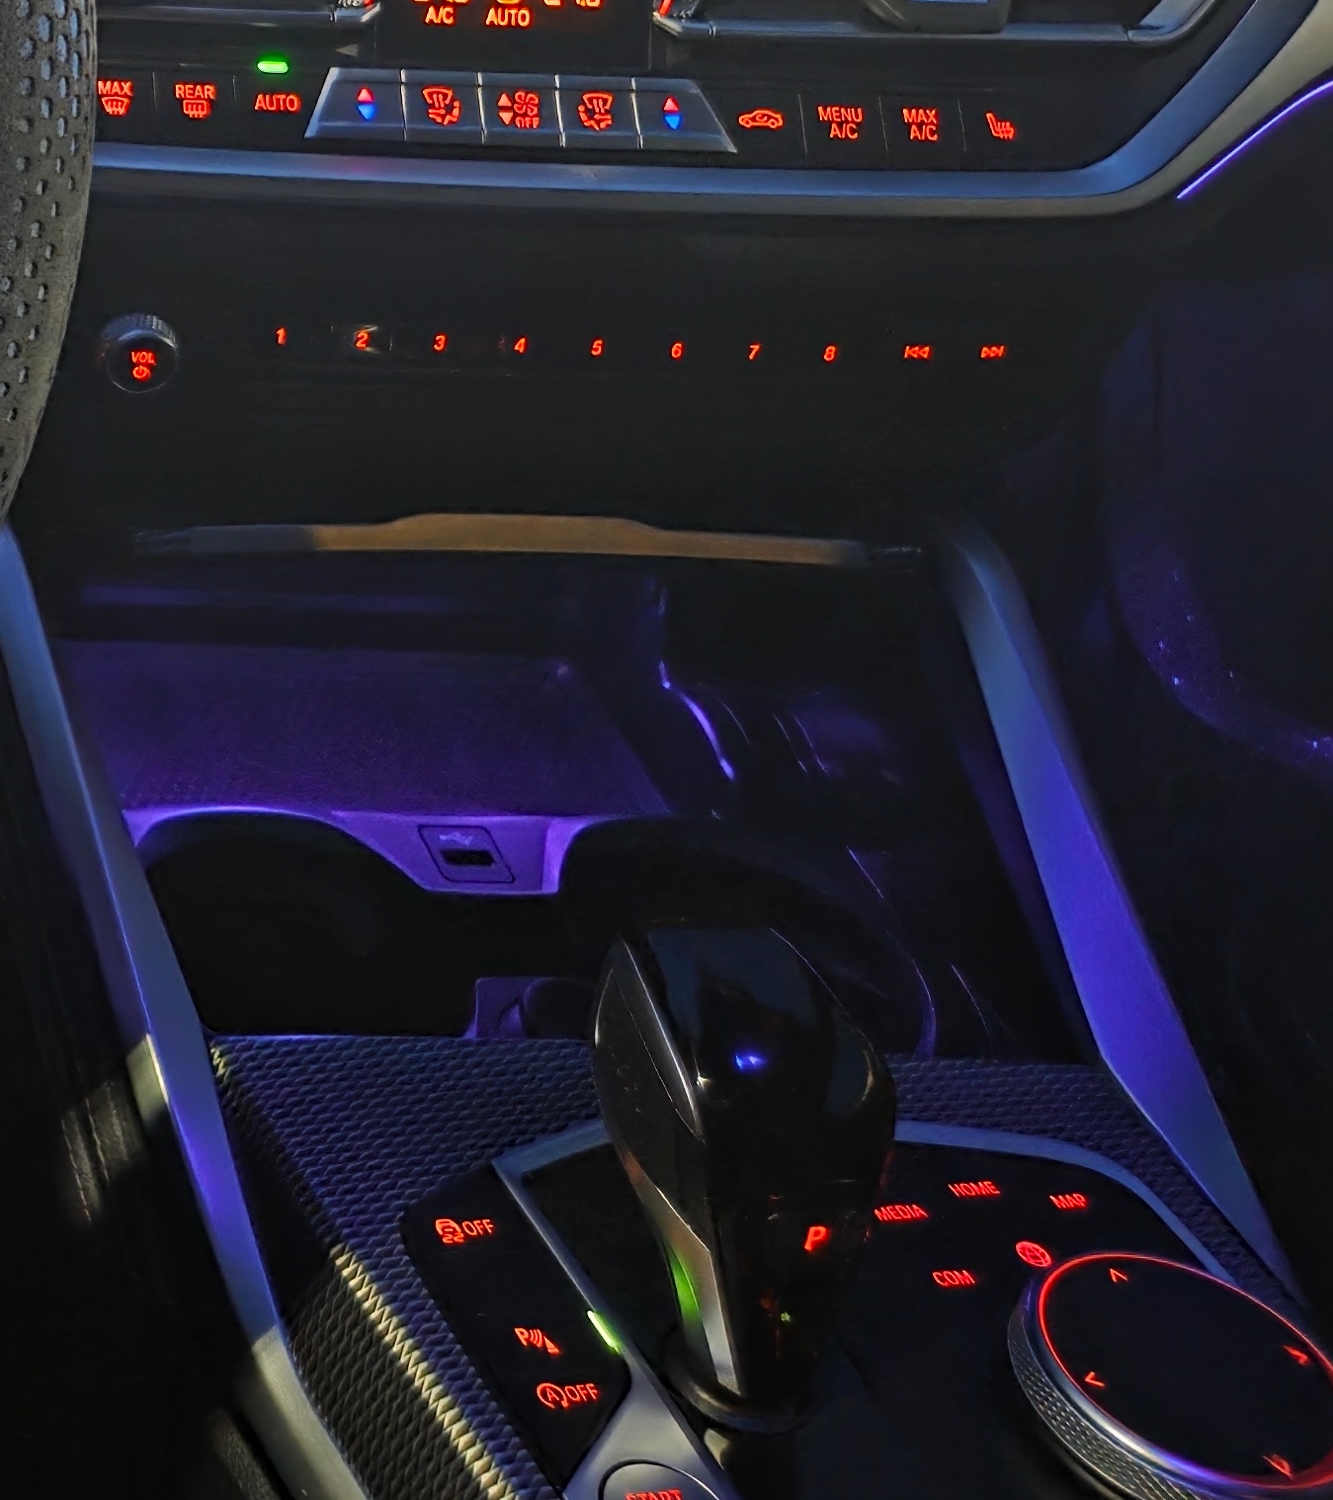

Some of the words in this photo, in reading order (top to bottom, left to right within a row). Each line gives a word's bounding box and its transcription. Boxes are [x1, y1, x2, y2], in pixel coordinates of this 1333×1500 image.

[425, 6, 454, 25] A/C
[486, 8, 530, 27] AUTO
[97, 80, 132, 98] MAX
[175, 83, 215, 101] REAR
[254, 93, 301, 114] AUTO
[515, 116, 540, 129] OFF
[818, 106, 863, 123] MENU
[903, 108, 938, 124] MAX
[829, 124, 858, 140] A/C
[910, 125, 938, 141] A/C
[276, 327, 287, 345] 1
[355, 331, 369, 349] 2
[433, 334, 447, 352] 3
[513, 336, 527, 354] 4
[590, 339, 604, 357] 5
[671, 342, 683, 359] 6
[748, 343, 761, 361] 7
[823, 345, 836, 362] 8
[130, 351, 156, 366] VOL
[948, 1180, 1001, 1198] HOME
[1049, 1194, 1087, 1210] MAP
[874, 1204, 929, 1222] MEDIA
[462, 1218, 494, 1237] OFF
[804, 1225, 827, 1251] P
[932, 1269, 976, 1287] COM
[565, 1382, 599, 1402] OFF
